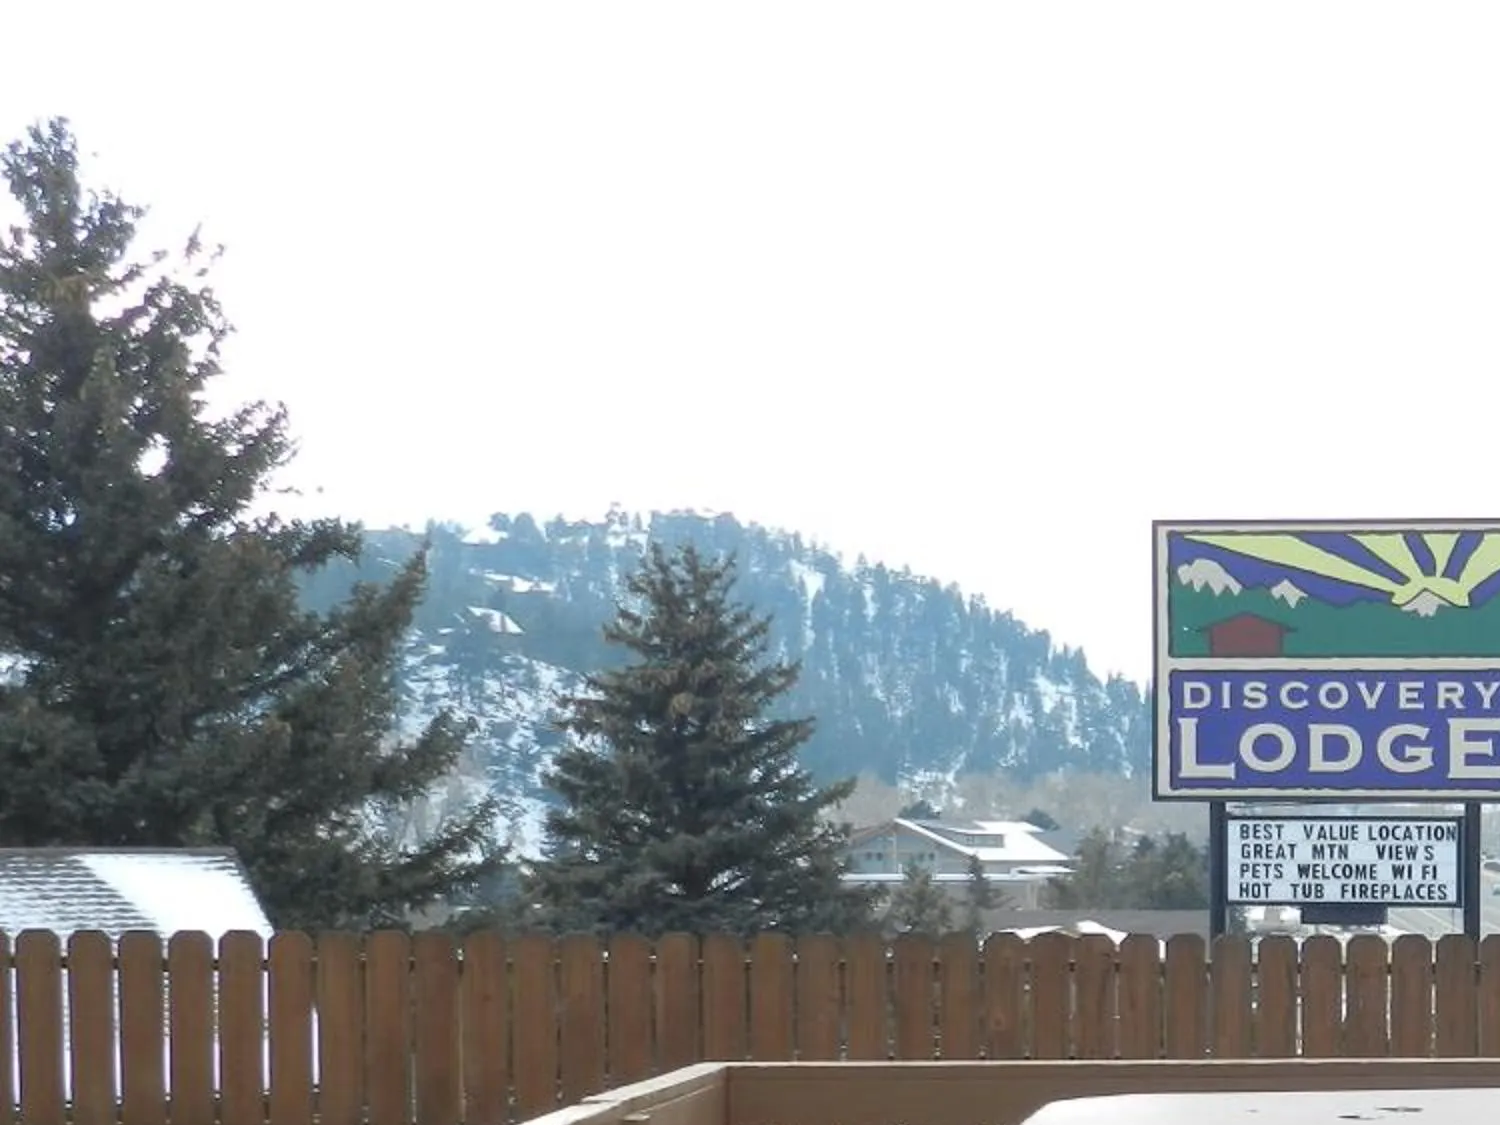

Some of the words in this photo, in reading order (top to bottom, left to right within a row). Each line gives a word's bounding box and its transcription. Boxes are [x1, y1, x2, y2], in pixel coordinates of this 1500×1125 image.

[1182, 681, 1500, 709] DISCOVERY
[1239, 824, 1284, 840] BEST
[1303, 825, 1359, 840] VALUE
[1368, 825, 1457, 841] LOCATION
[1241, 843, 1297, 860] GREAT
[1312, 845, 1349, 860] MTN
[1376, 845, 1434, 860] VIEWS
[1239, 863, 1284, 879] PETS
[1297, 864, 1377, 879] WELCOME
[1392, 865, 1412, 879] WI
[1422, 865, 1437, 879] FI
[1239, 883, 1272, 899] HOT
[1290, 883, 1325, 898] TUB
[1341, 884, 1448, 900] FIREPLACES
